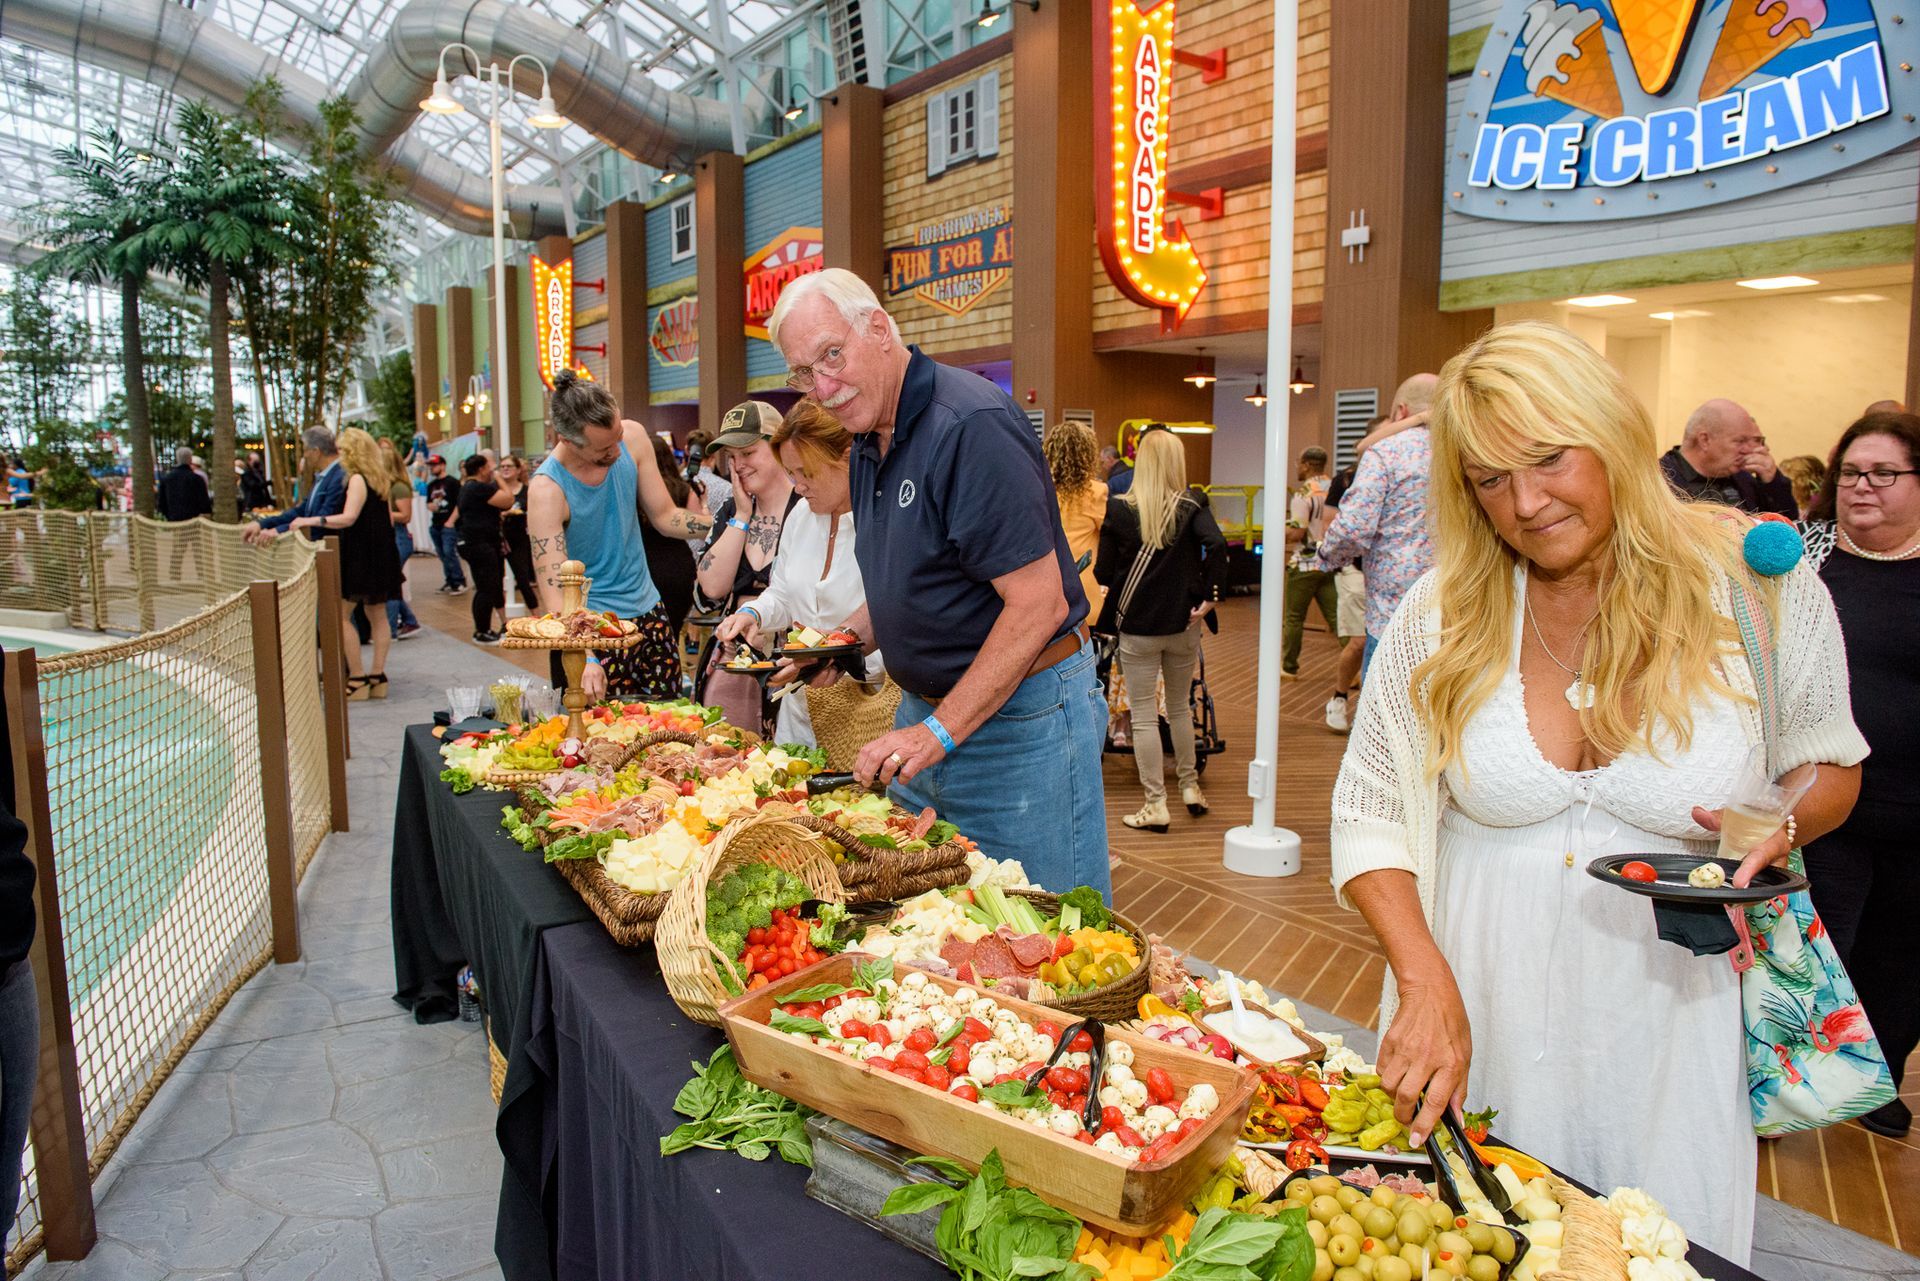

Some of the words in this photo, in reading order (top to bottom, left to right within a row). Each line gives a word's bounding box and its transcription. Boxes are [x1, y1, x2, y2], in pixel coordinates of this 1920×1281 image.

[1134, 36, 1160, 253] ARCADE
[1469, 122, 1584, 190] ICE
[1590, 40, 1890, 187] CREAM
[891, 248, 931, 292] FUN
[938, 238, 983, 273] FOR
[936, 278, 982, 300] GAMES
[549, 279, 564, 374] ARCADE
